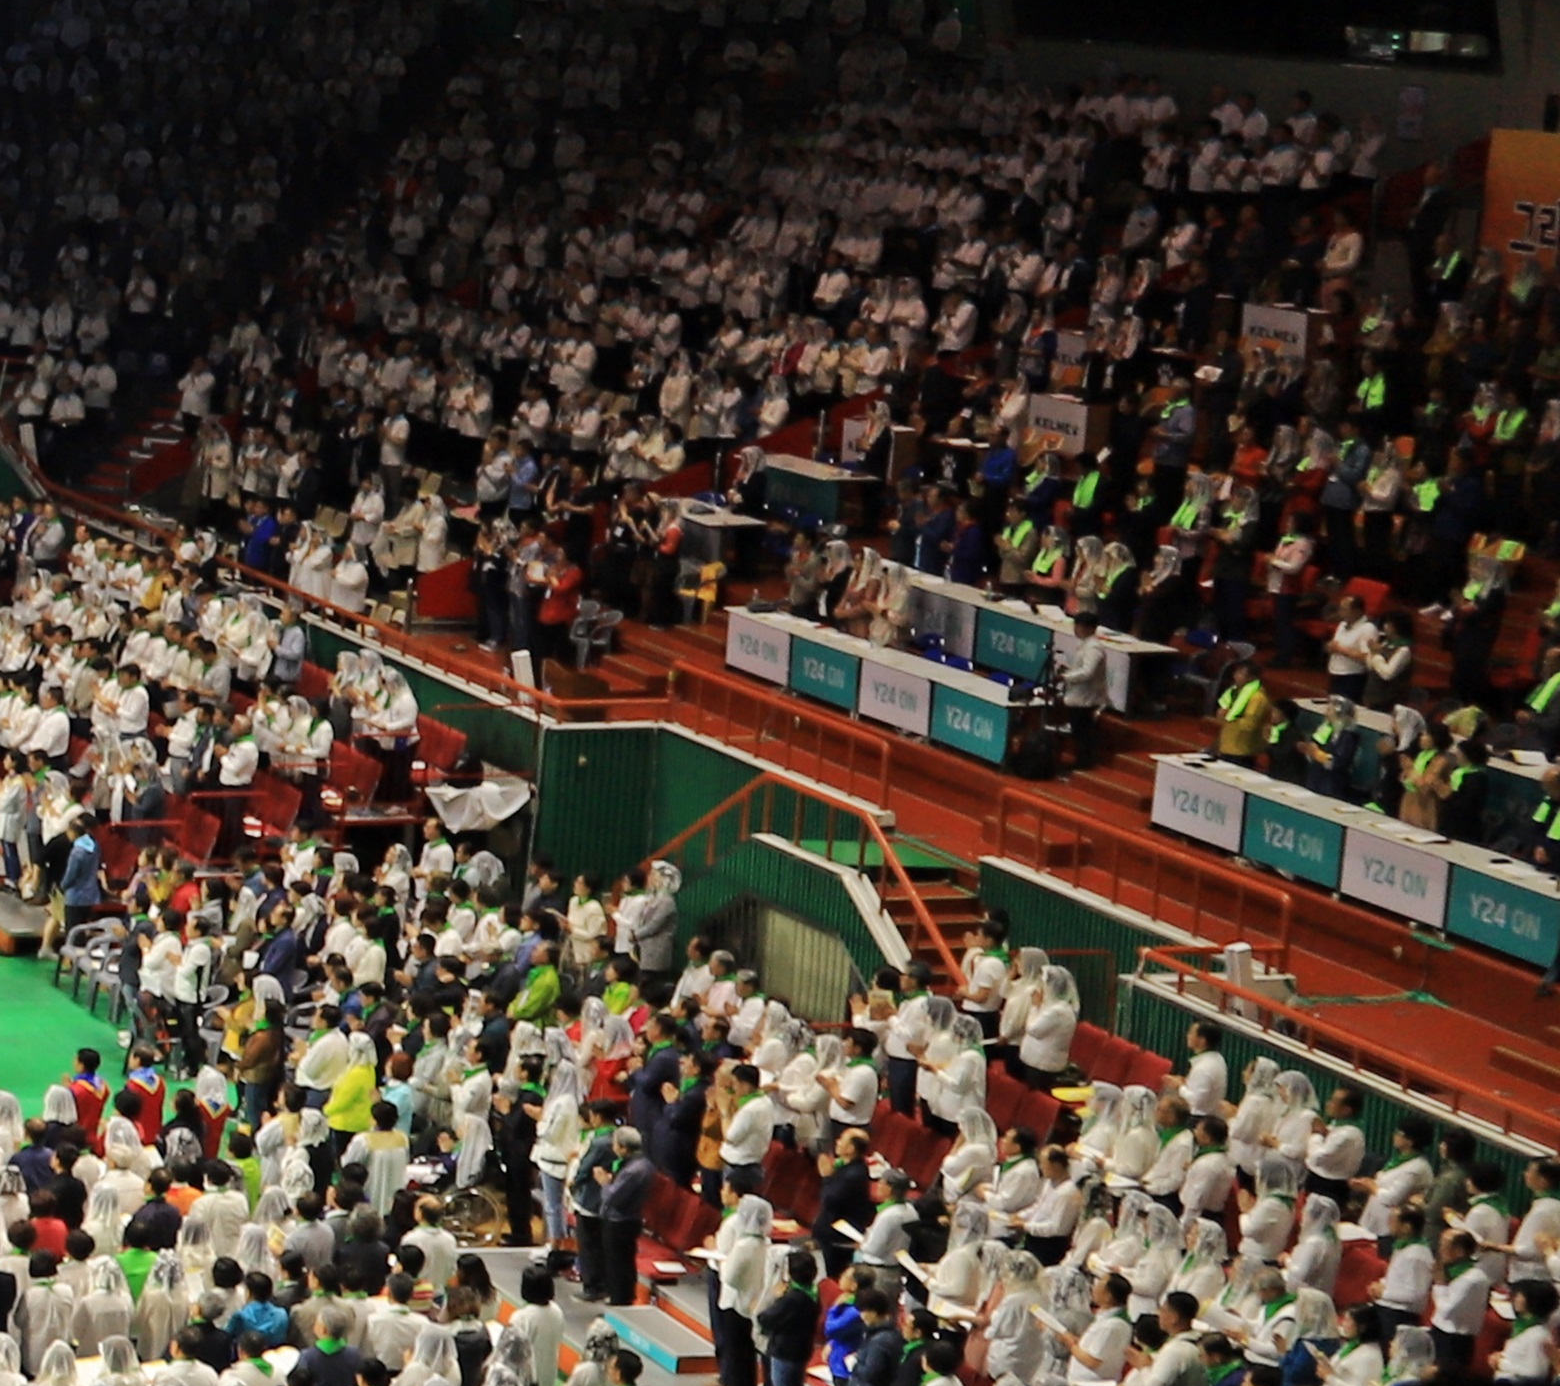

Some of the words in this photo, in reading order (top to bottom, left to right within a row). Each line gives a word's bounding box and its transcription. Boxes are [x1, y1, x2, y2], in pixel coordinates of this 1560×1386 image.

[739, 636, 761, 660] Y24
[988, 627, 1015, 653] Y24
[1016, 636, 1037, 662] ON
[802, 656, 827, 682] Y24
[872, 681, 897, 706] Y24
[898, 686, 917, 711] ON
[944, 704, 972, 732] Y24
[973, 713, 994, 741] ON
[1169, 788, 1200, 816] Y24
[1202, 797, 1227, 827] ON
[1262, 818, 1295, 851] Y24
[1296, 831, 1325, 862] ON
[1362, 855, 1396, 887] Y24
[1400, 867, 1429, 899] ON
[1469, 893, 1506, 927] Y24
[1510, 908, 1541, 942] ON
